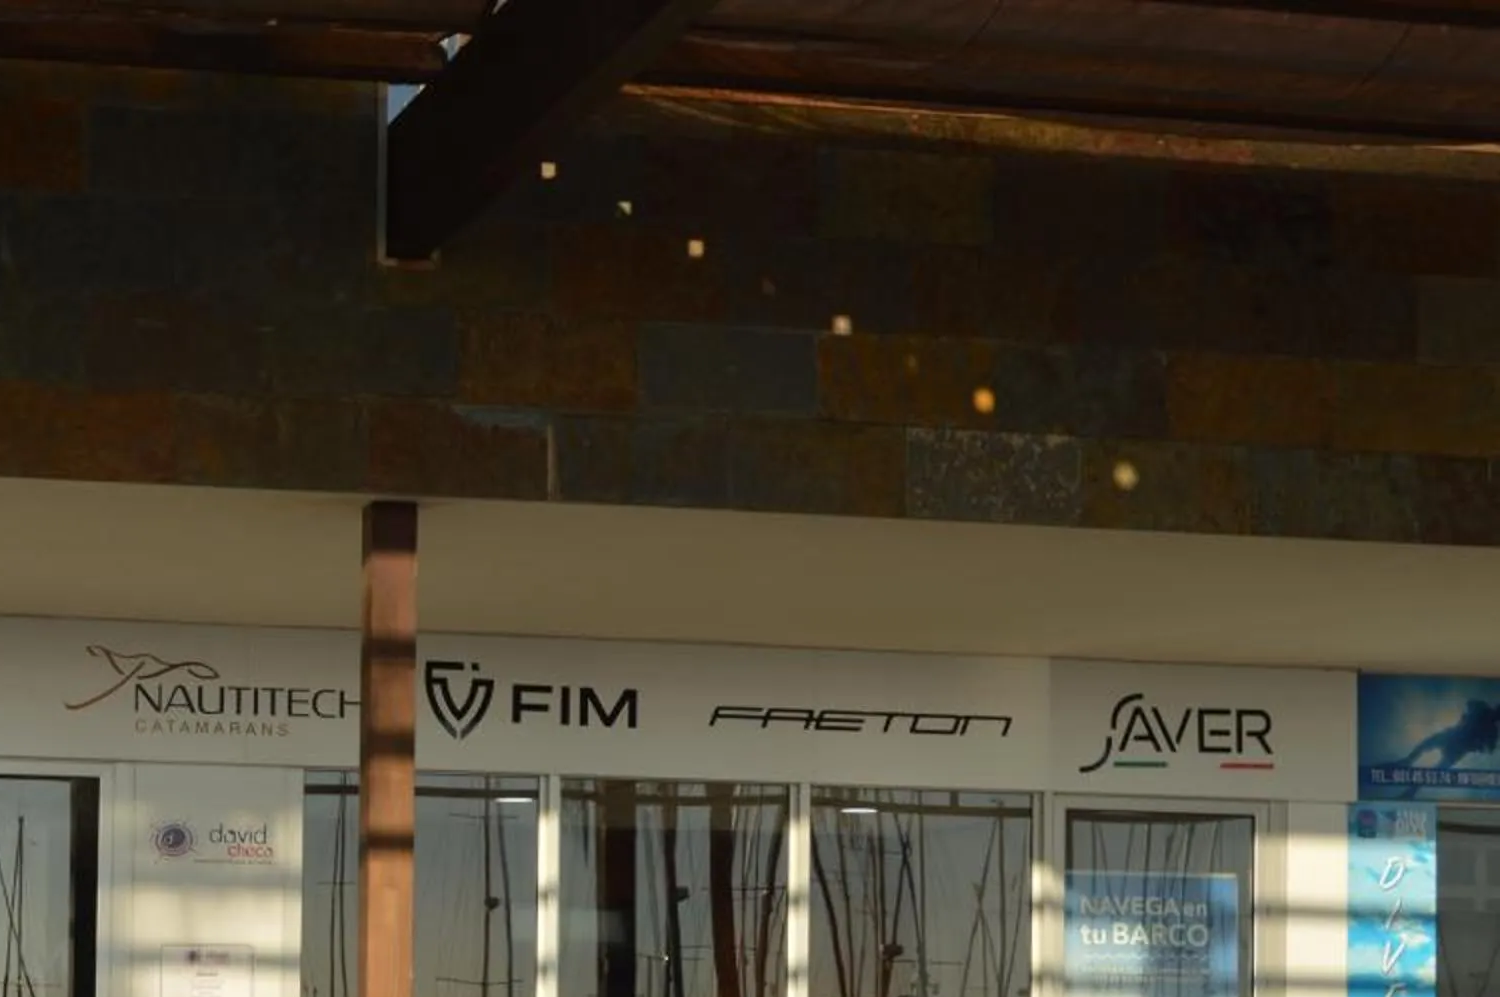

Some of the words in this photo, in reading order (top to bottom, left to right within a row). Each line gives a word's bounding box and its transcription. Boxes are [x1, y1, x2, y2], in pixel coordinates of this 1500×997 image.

[134, 683, 362, 719] NAUTITECH
[511, 684, 638, 730] FIM
[134, 718, 291, 737] CATAMARANS
[709, 705, 1013, 737] FAETON
[1079, 693, 1274, 773] SAVER
[208, 823, 268, 845] david
[1080, 896, 1181, 917] NAVEGA
[1183, 902, 1208, 918] en
[1080, 924, 1106, 945] tu
[1112, 922, 1209, 948] BARCO
